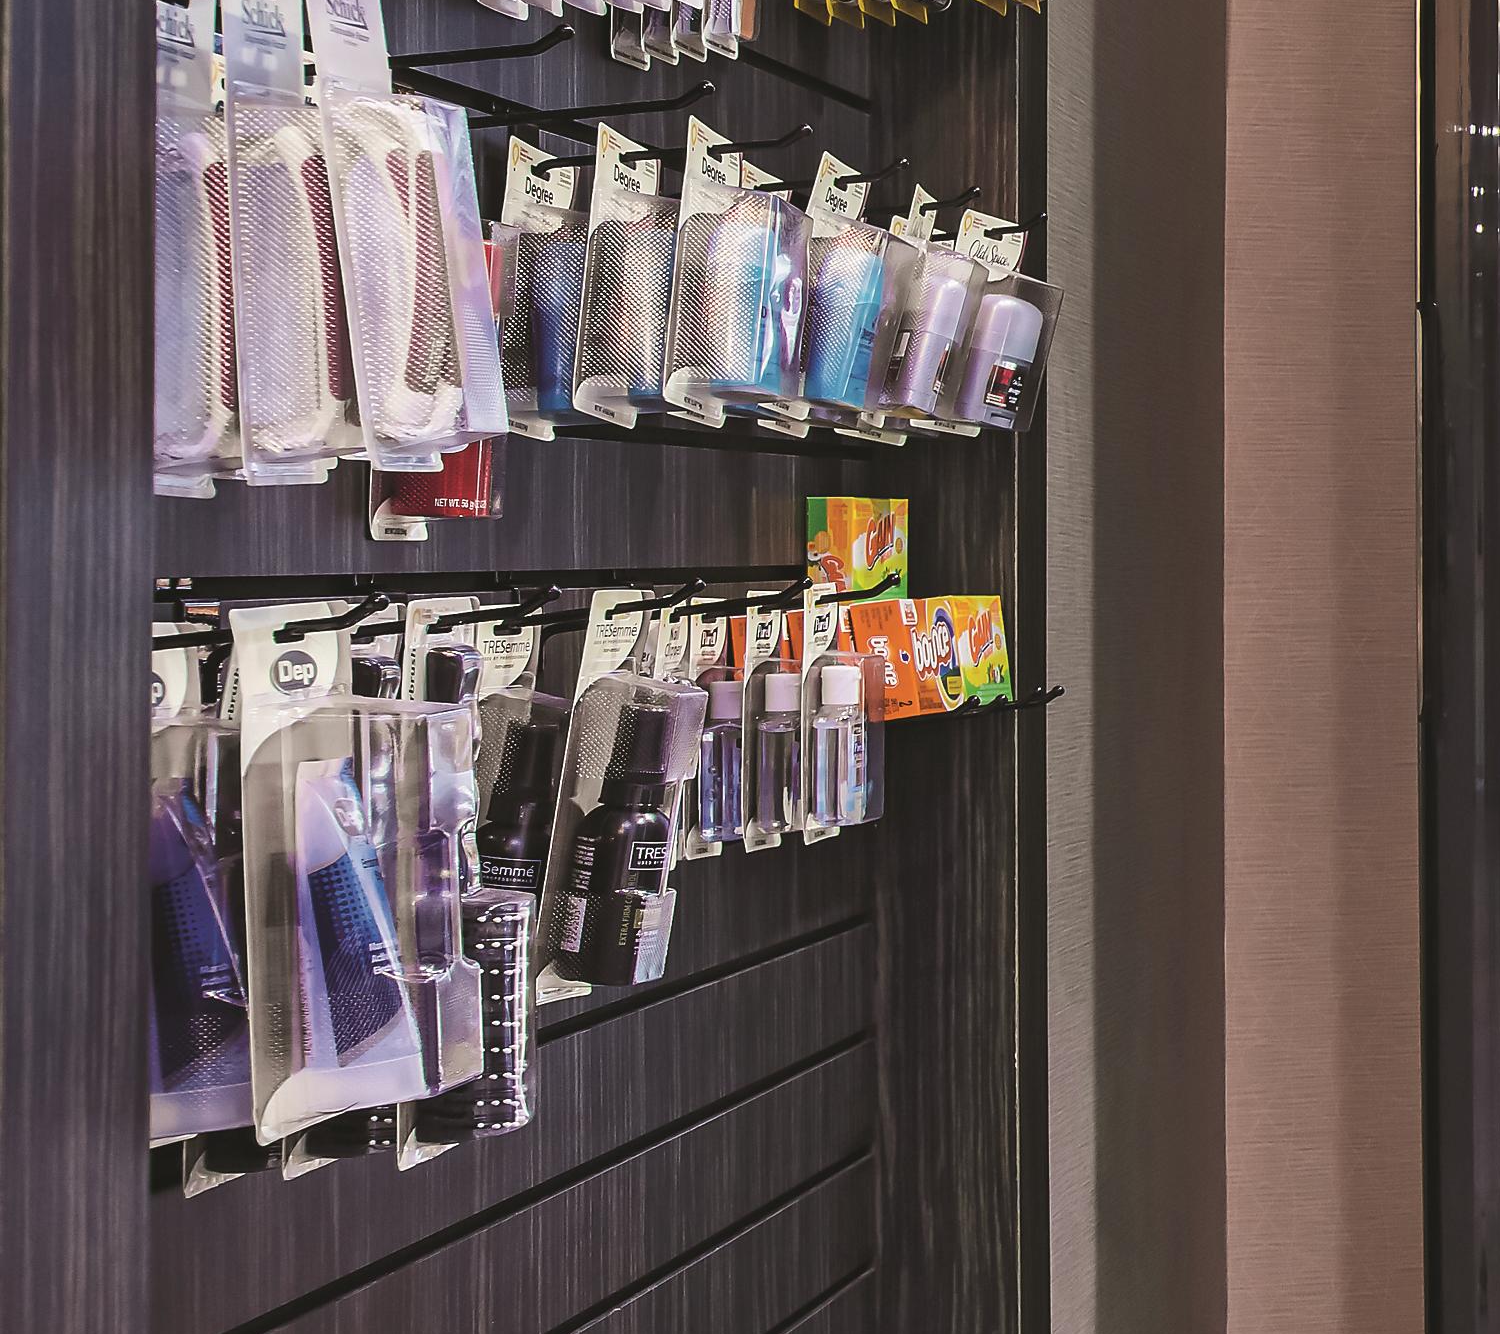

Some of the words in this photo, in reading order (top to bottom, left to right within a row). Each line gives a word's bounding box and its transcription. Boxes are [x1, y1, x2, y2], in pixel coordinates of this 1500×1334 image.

[525, 176, 556, 205] Degree
[612, 163, 642, 194] Degree
[968, 239, 987, 261] Old
[985, 245, 1008, 267] Spice
[866, 512, 895, 570] GAIN
[595, 621, 639, 639] TRESemmé
[482, 637, 532, 655] TRESemmé
[912, 622, 953, 679] bounce
[277, 658, 315, 683] Dep
